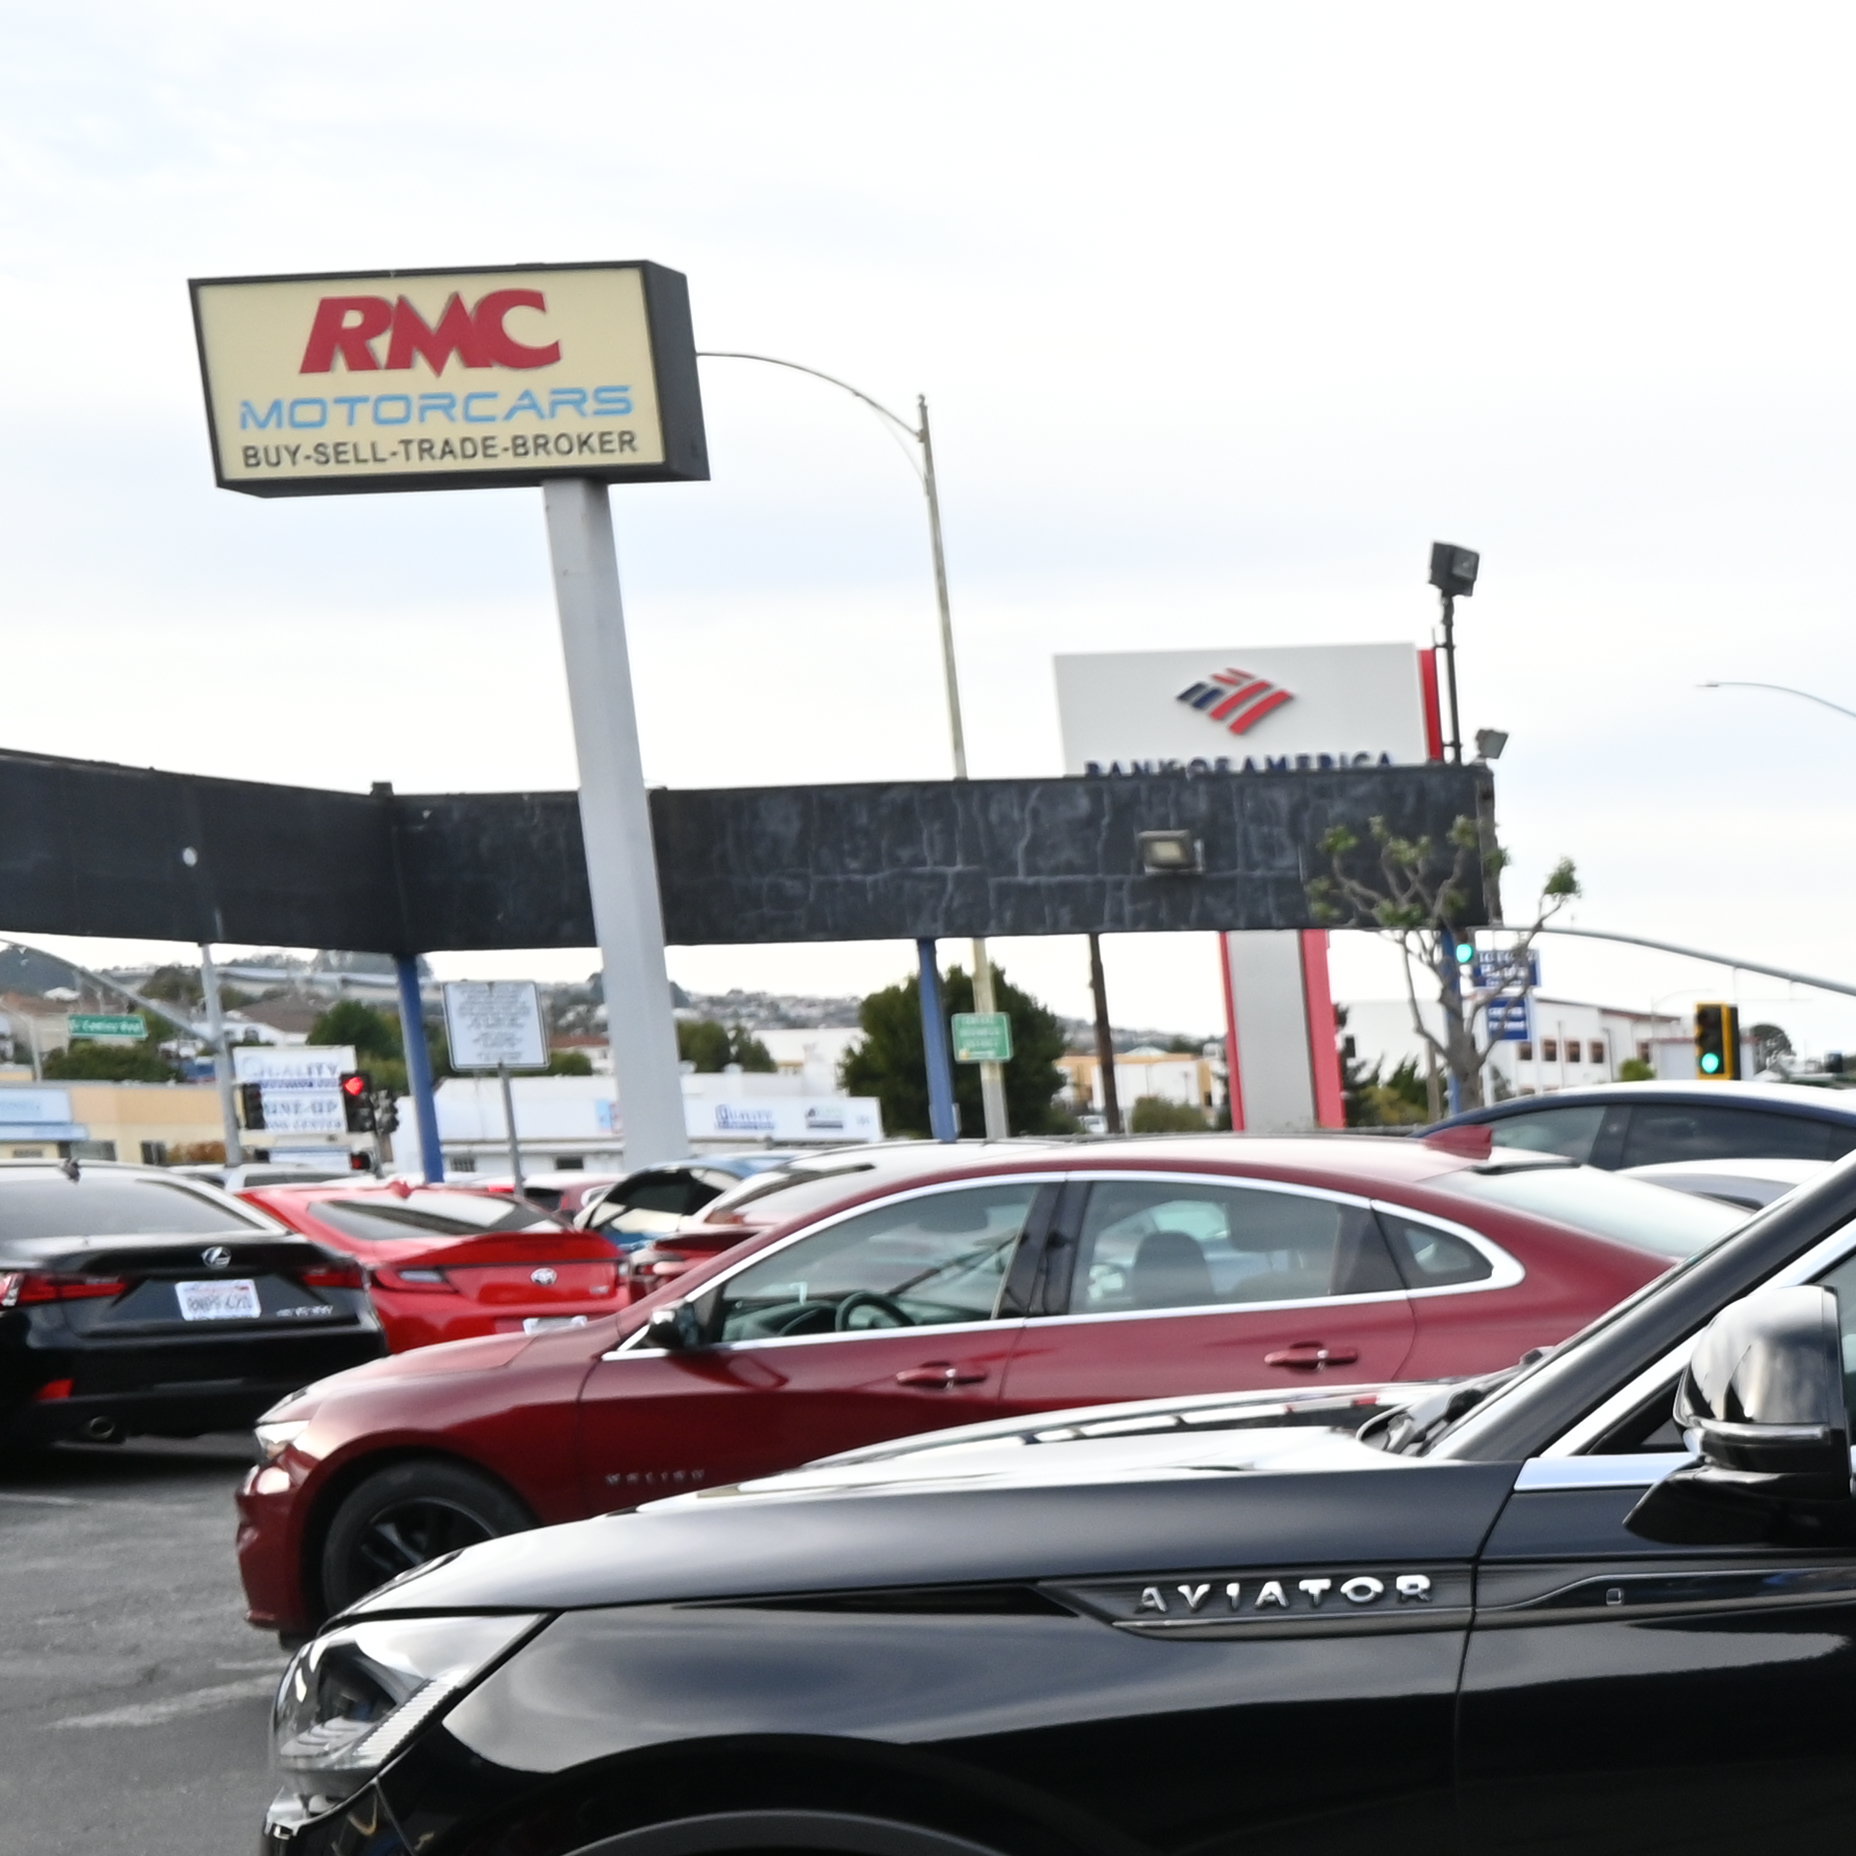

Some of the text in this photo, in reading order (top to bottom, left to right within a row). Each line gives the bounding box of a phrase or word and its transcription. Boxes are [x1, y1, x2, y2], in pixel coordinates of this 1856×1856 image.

[299, 288, 562, 378] RMC
[239, 385, 635, 431] MOTORCARS
[242, 430, 638, 468] BUY-SELL-TRADE-BROKER
[1134, 1573, 1432, 1614] AVIATOR
